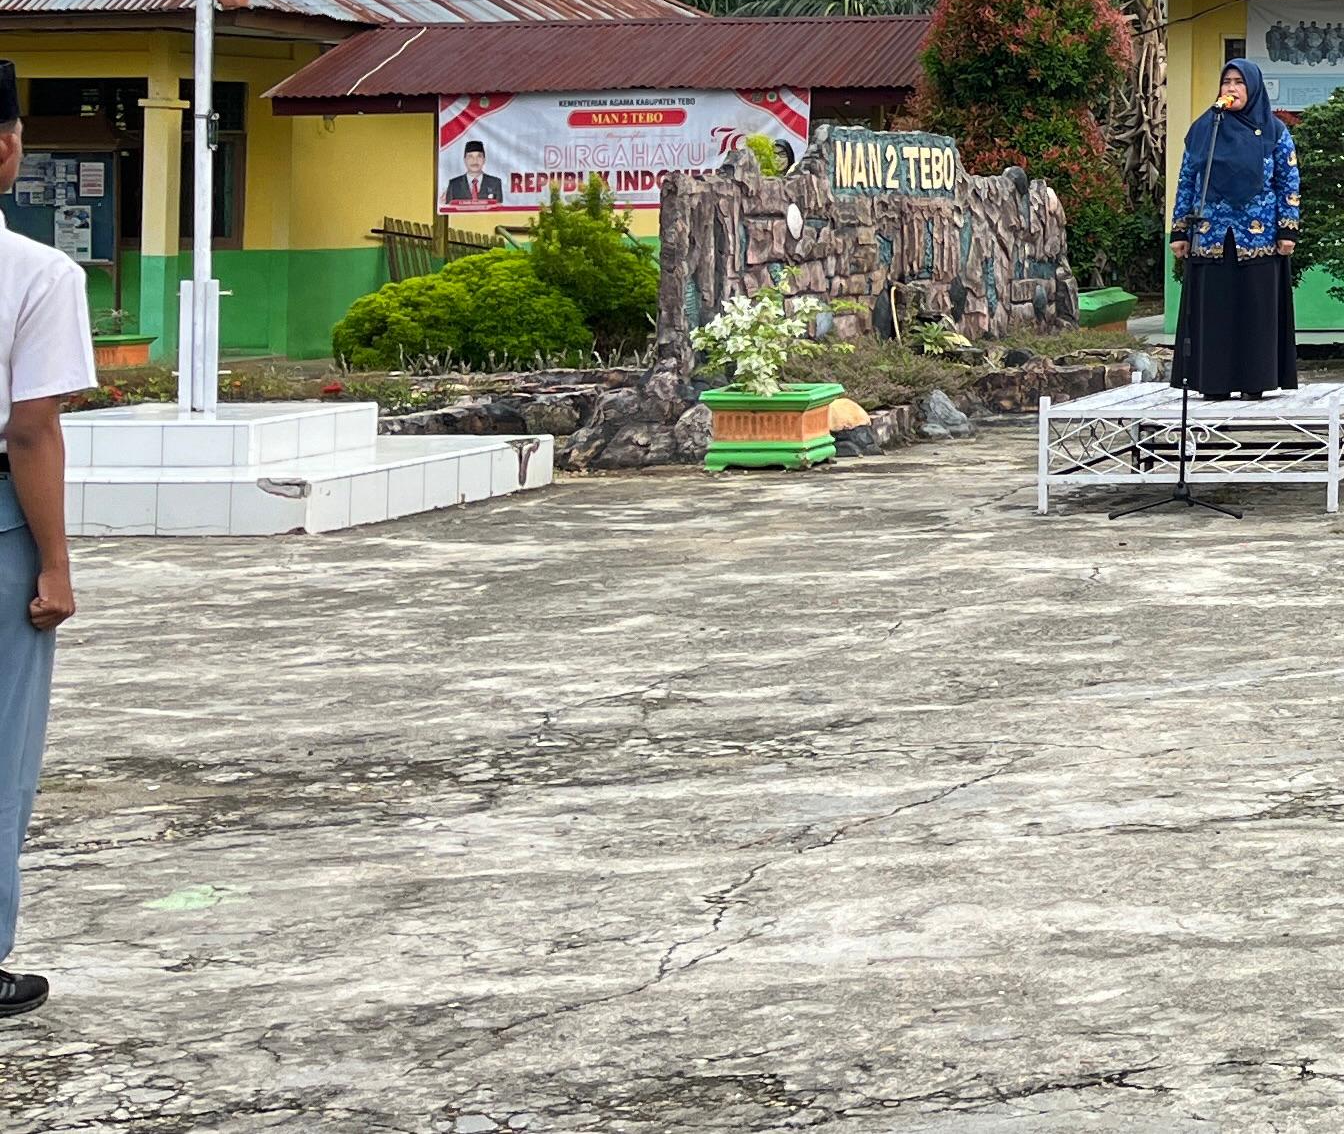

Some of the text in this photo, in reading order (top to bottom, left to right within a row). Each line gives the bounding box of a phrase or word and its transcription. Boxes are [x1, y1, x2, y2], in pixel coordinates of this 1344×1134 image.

[559, 99, 608, 107] KEMENTERIAN
[678, 97, 696, 105] TEBO
[592, 112, 664, 124] MAN 2 TEBO
[544, 141, 706, 169] DIRGAHAYU
[835, 141, 955, 191] MAN 2 TEBO
